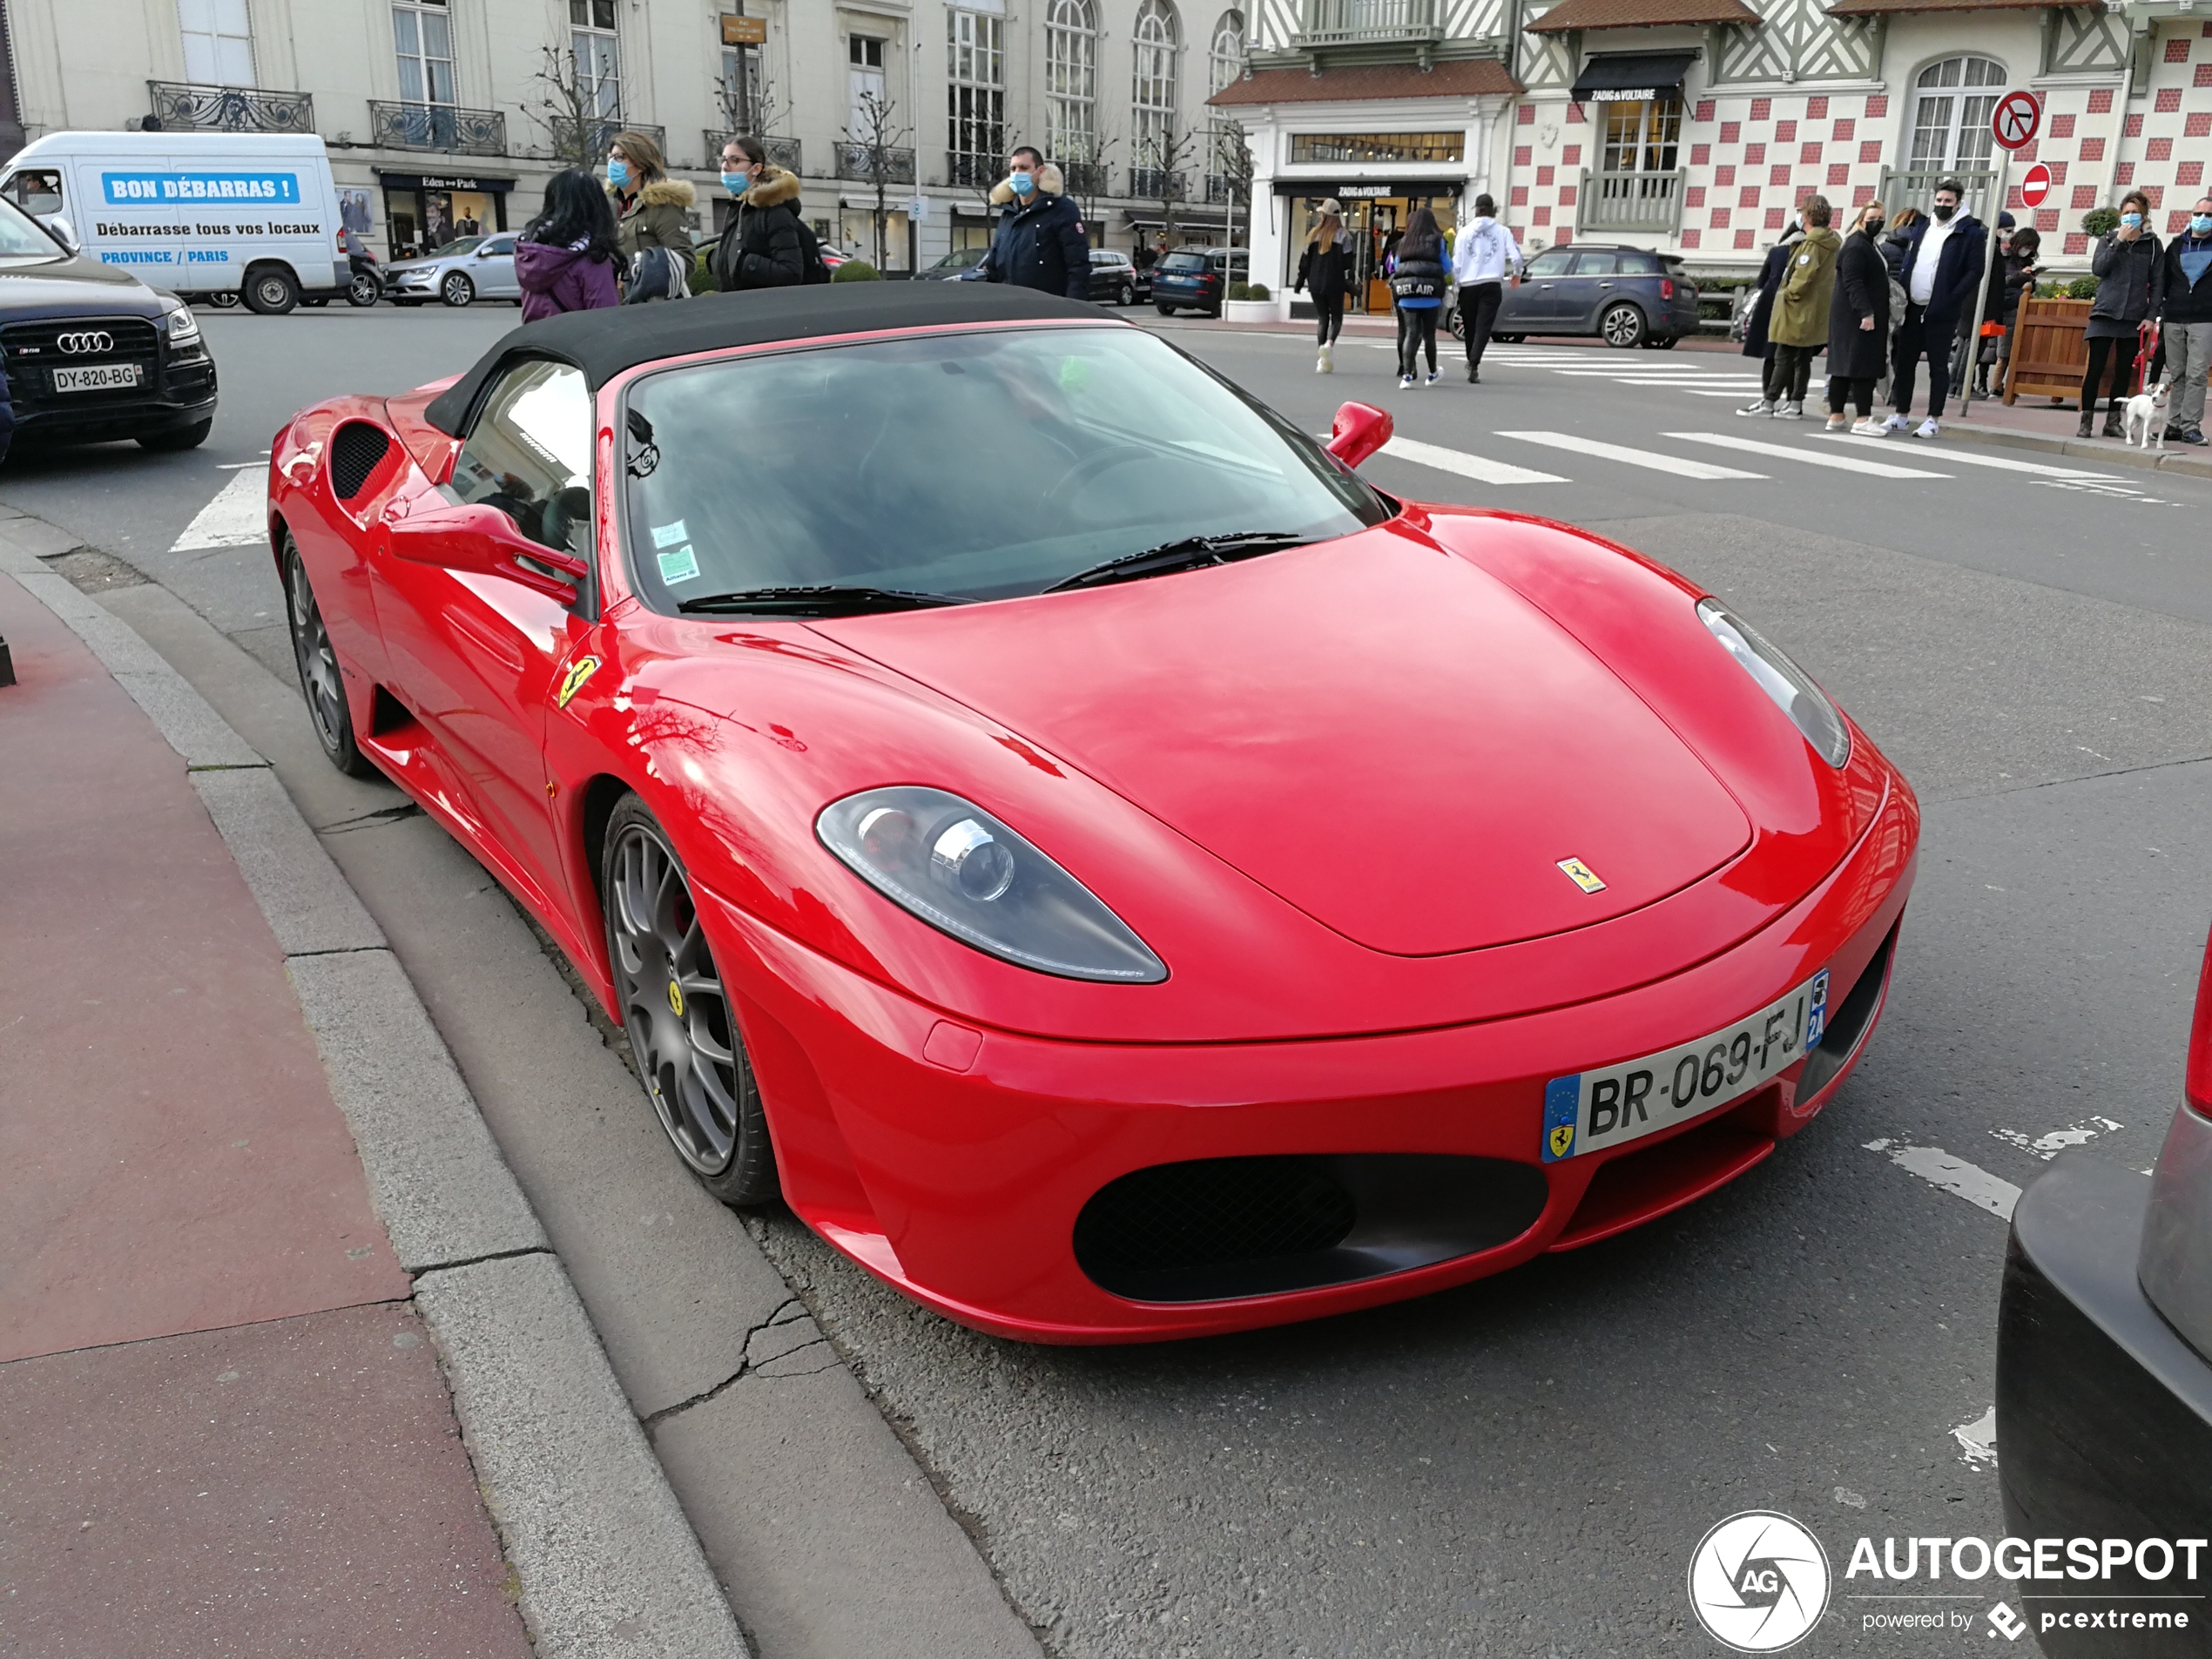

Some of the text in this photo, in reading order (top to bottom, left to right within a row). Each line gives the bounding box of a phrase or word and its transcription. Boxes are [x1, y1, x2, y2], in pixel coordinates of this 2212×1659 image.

[111, 180, 158, 198] BON
[163, 176, 276, 198] DÉBARRAS
[422, 177, 477, 189] Eden Park
[96, 221, 320, 236] Débarrasse tous vos locaux
[101, 251, 172, 264] PROVINCE
[187, 251, 229, 262] PARIS
[1396, 284, 1434, 295] BEL AIR
[57, 368, 133, 388] DY-820-BG
[1807, 1009, 1824, 1043] 2A
[1588, 995, 1804, 1137] BR-069-FJ
